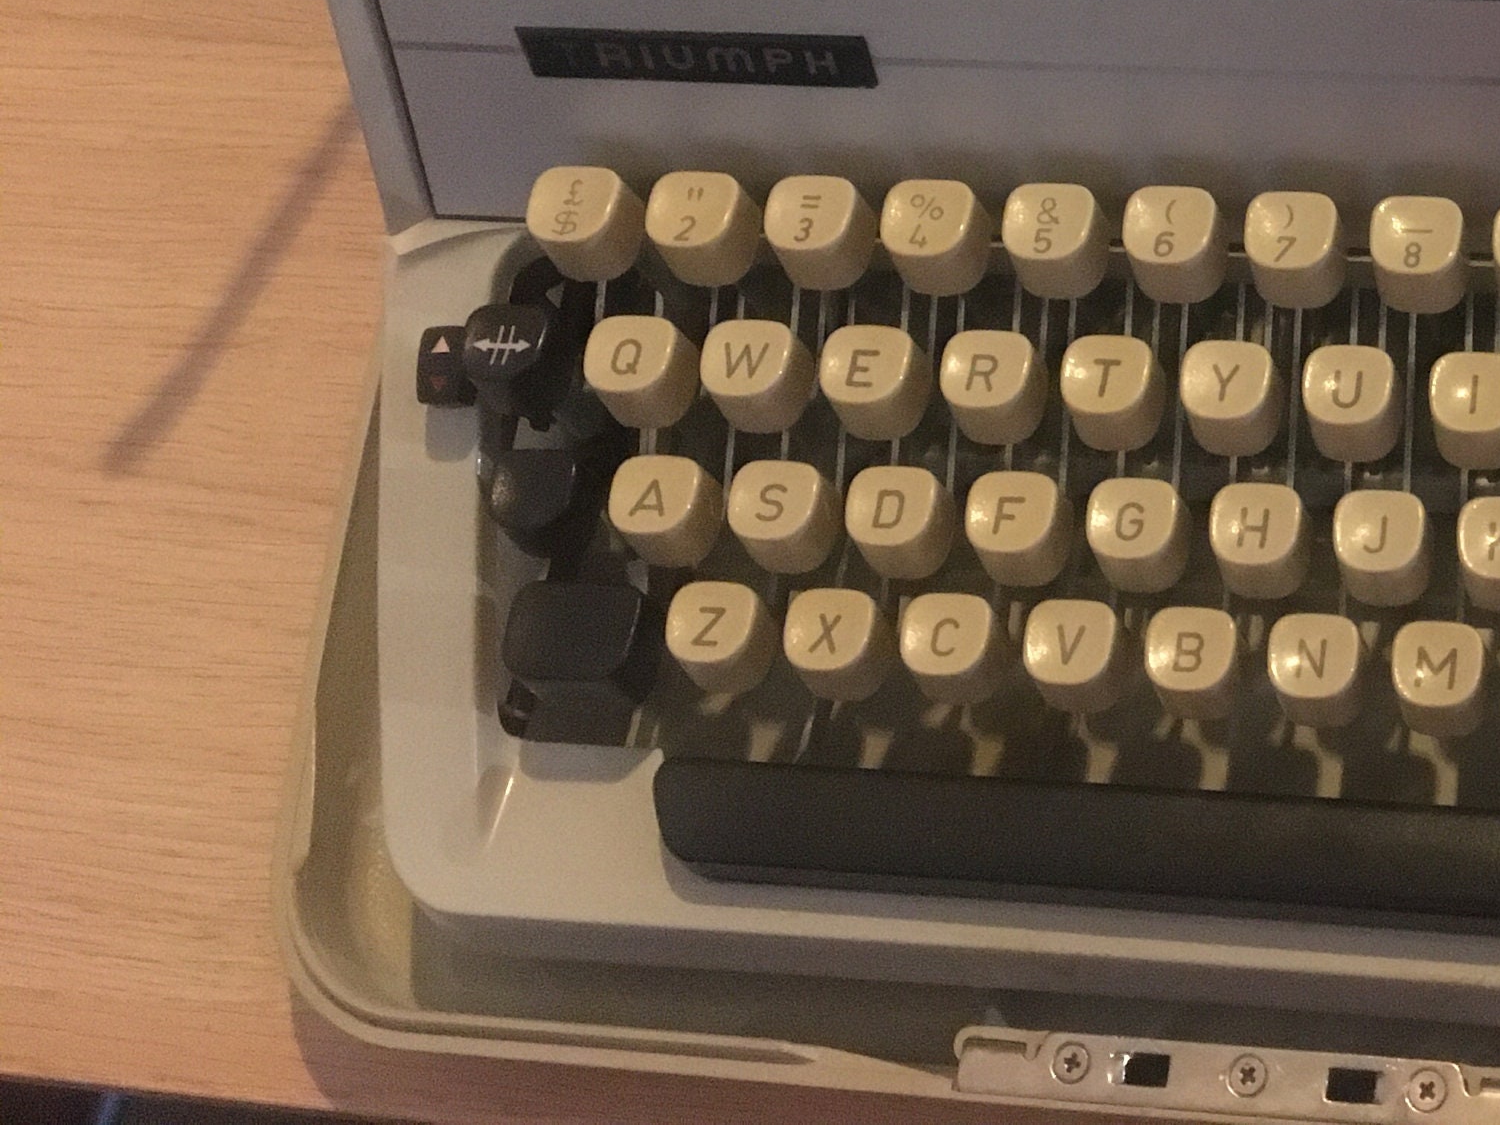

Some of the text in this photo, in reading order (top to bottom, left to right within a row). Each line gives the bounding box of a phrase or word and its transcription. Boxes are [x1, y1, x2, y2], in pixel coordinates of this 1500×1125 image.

[561, 40, 840, 76] TRIUMPH
[562, 179, 584, 206] £
[910, 193, 944, 221] %
[1037, 196, 1060, 226] &
[552, 210, 579, 236] $
[673, 215, 696, 242] 2
[793, 216, 814, 242] 3
[908, 223, 929, 249] 4
[1033, 227, 1052, 253] 5
[1154, 231, 1174, 258] 6
[1274, 236, 1296, 263] 7
[1403, 241, 1421, 267] 8
[610, 338, 642, 375] Q
[723, 342, 770, 379] W
[845, 349, 880, 388] E
[964, 353, 998, 392] R
[1093, 358, 1122, 398] T
[1211, 363, 1241, 402] Y
[1330, 368, 1363, 409] U
[628, 479, 666, 518] A
[754, 483, 788, 523] S
[871, 488, 905, 529] D
[991, 495, 1026, 535] F
[1114, 501, 1145, 541] G
[1235, 506, 1271, 550] H
[1362, 514, 1389, 555] J
[690, 606, 726, 647] Z
[807, 612, 842, 655] X
[929, 617, 960, 657] C
[1055, 623, 1087, 666] V
[1171, 631, 1206, 673] B
[1293, 637, 1328, 680] N
[1413, 645, 1459, 691] M
